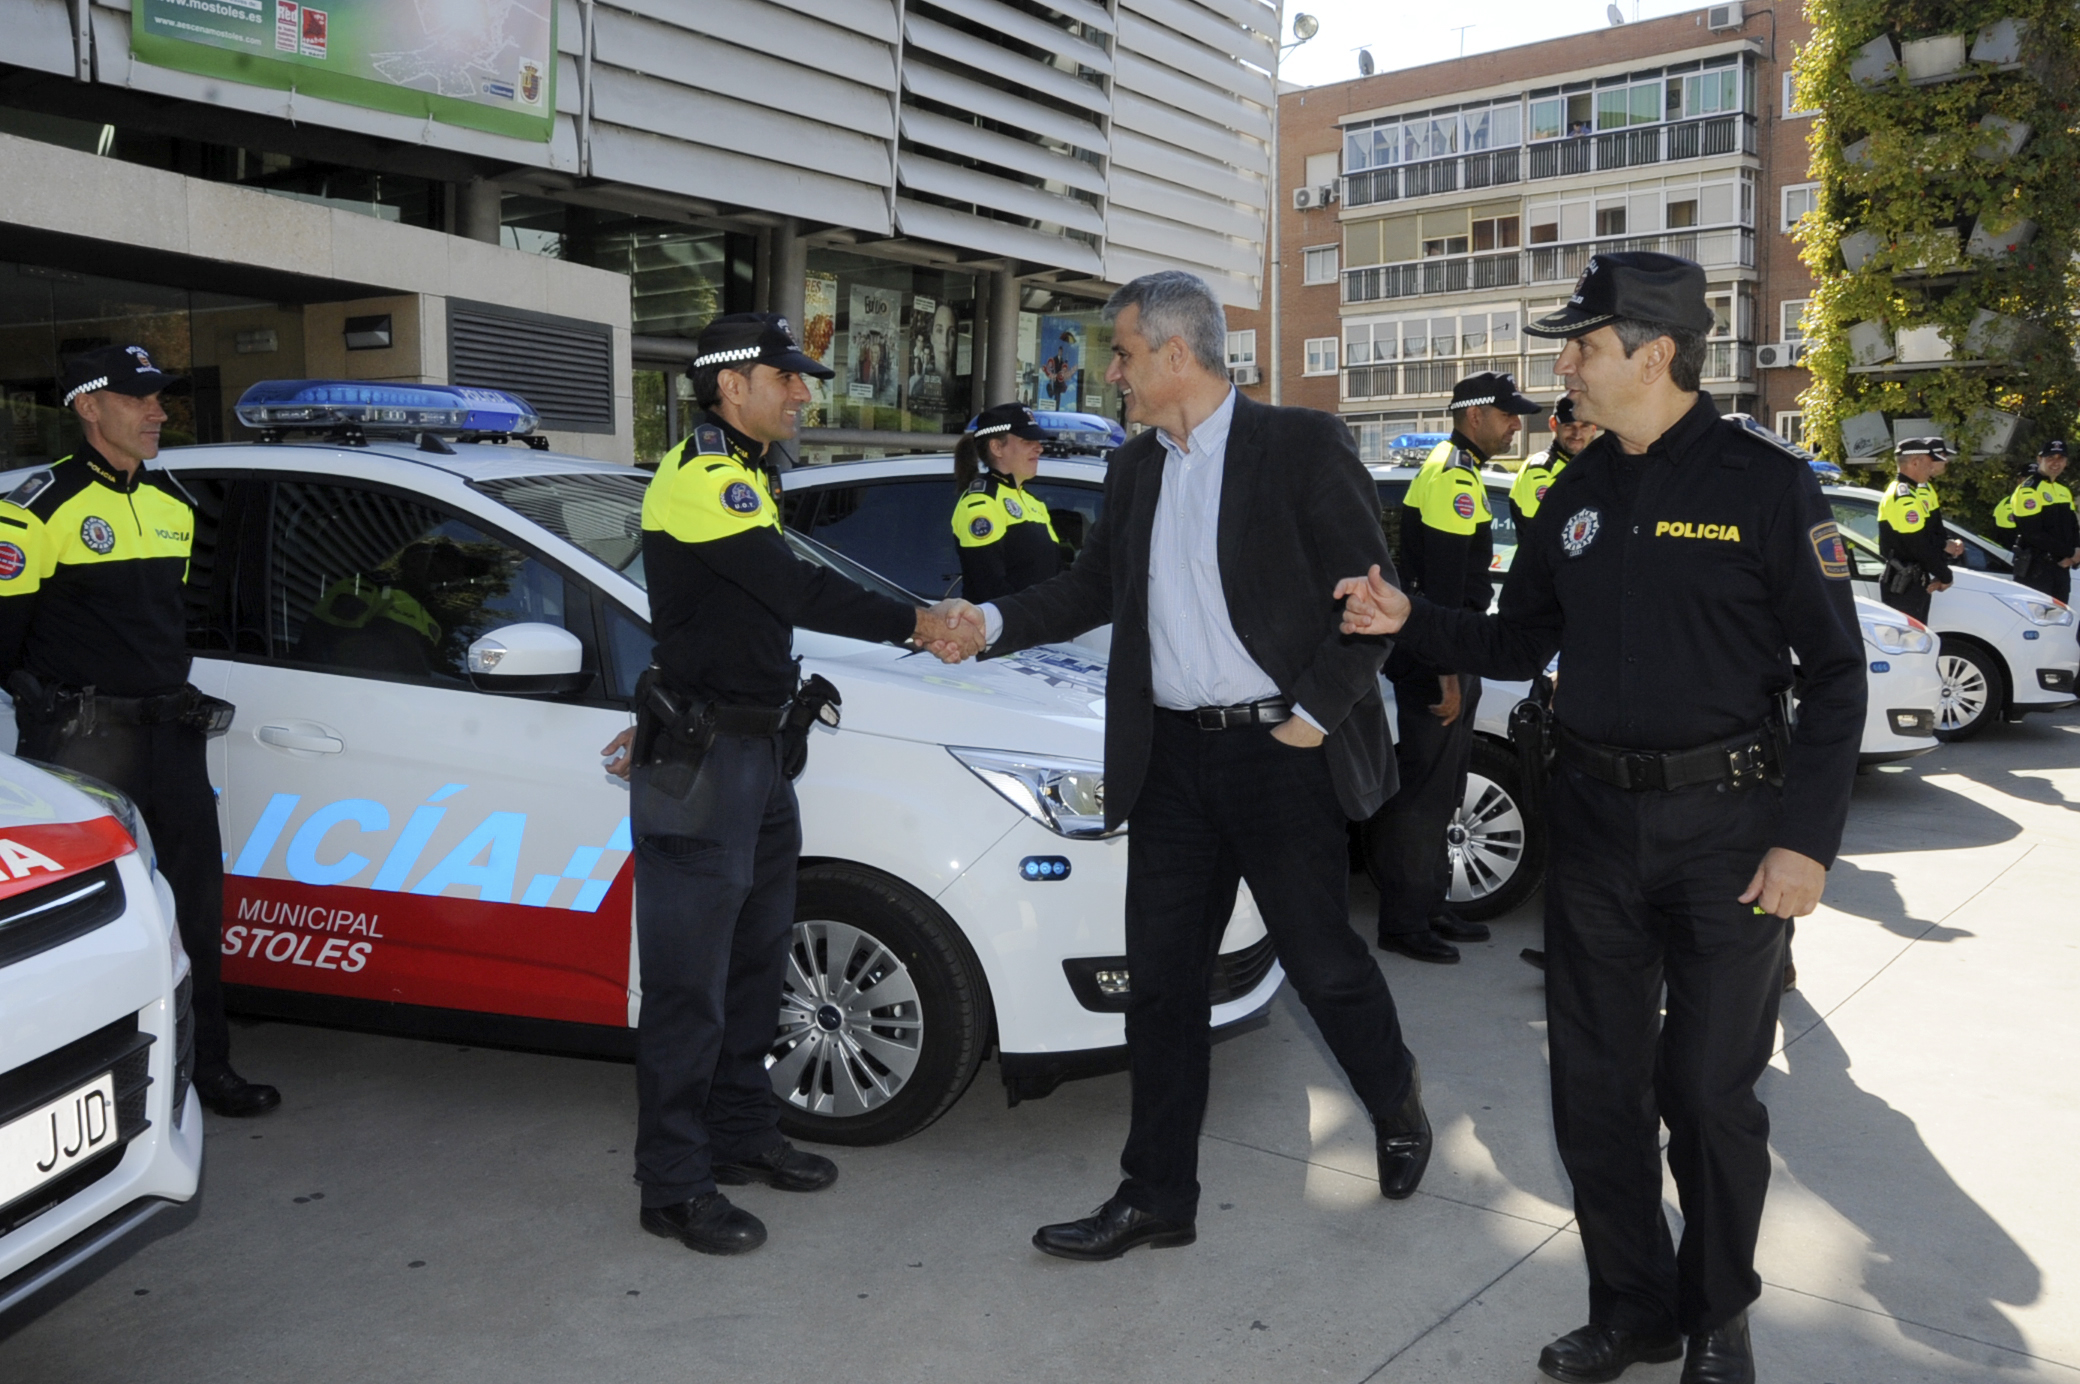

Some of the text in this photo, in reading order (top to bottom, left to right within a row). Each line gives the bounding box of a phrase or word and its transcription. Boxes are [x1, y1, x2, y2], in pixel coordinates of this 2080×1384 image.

[86, 460, 117, 483] POLICIA
[154, 527, 190, 542] POLICIA
[1655, 520, 1741, 543] POLICIA
[214, 783, 527, 904] ICÍA
[237, 897, 384, 938] MUNICIPAL
[221, 925, 373, 973] STOLES
[36, 1089, 108, 1173] JJD
